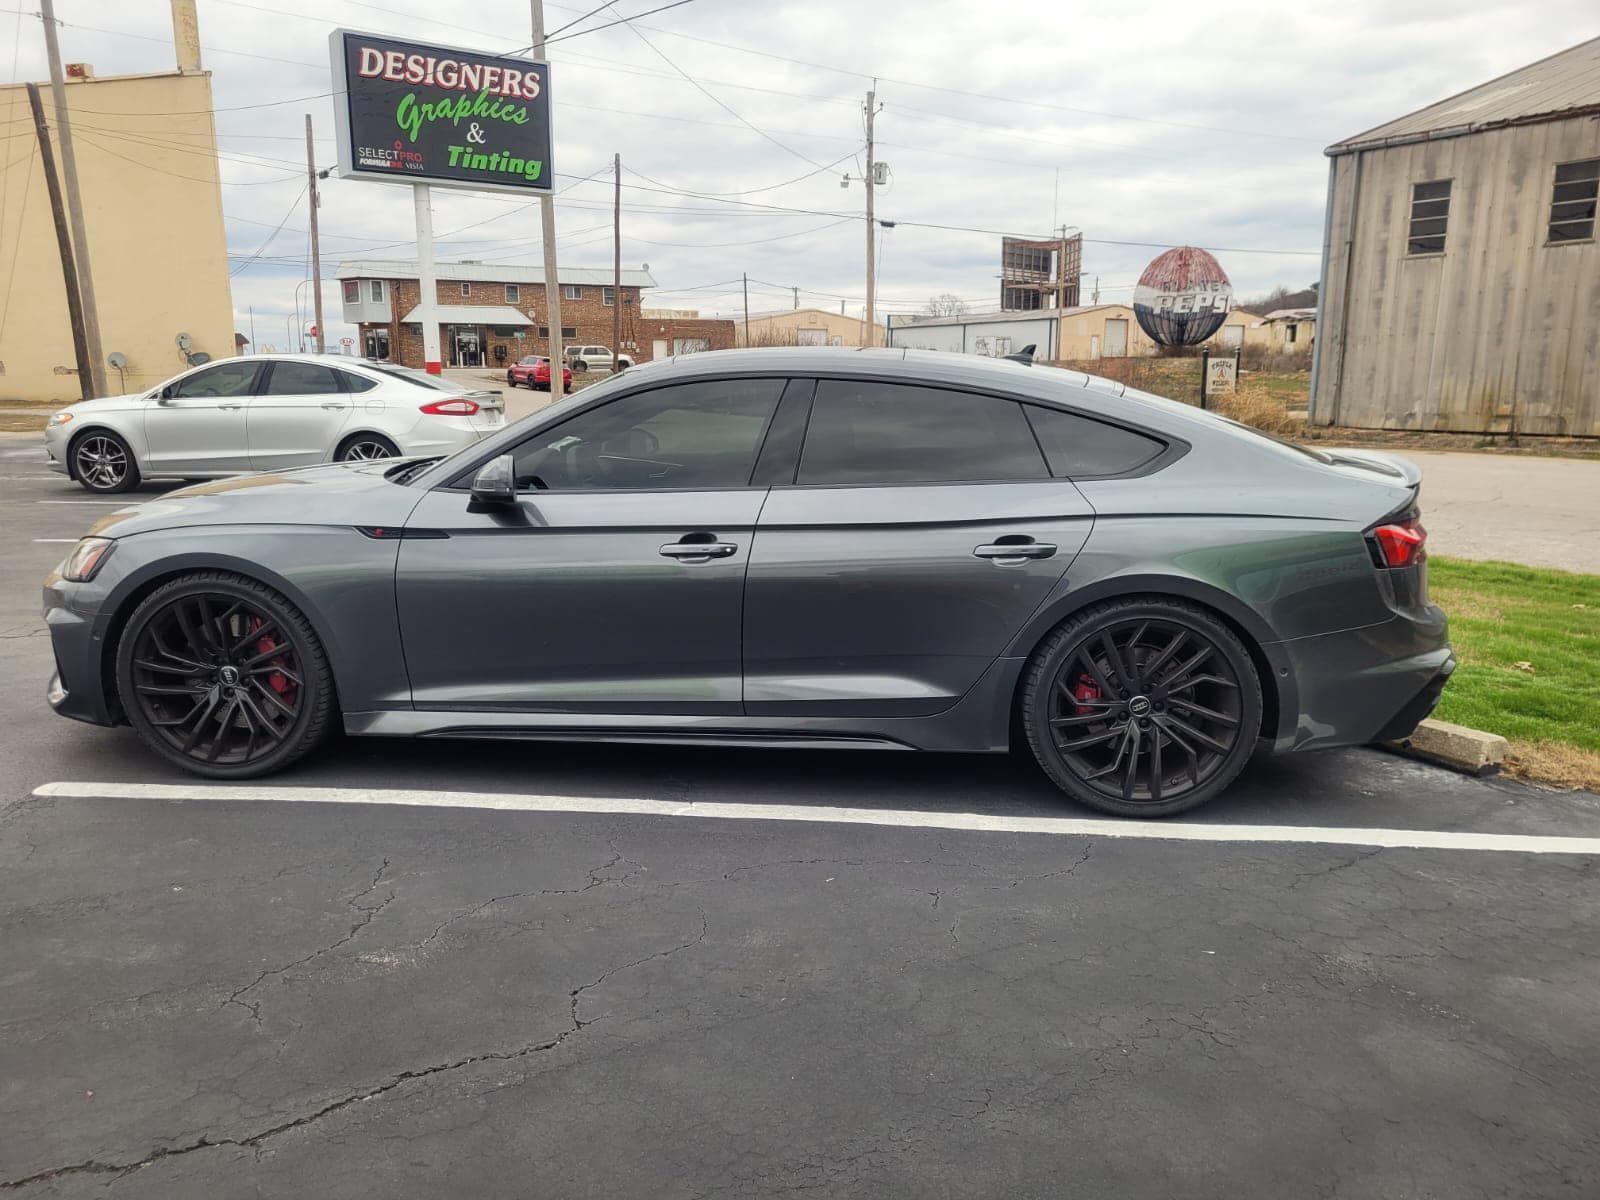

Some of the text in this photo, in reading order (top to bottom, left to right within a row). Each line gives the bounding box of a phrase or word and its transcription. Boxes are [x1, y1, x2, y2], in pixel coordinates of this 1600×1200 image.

[359, 47, 540, 100] DESIGNERS
[396, 85, 530, 142] Graphics
[466, 122, 486, 144] &
[447, 145, 542, 180] Tinting
[1152, 293, 1231, 315] PEPSI
